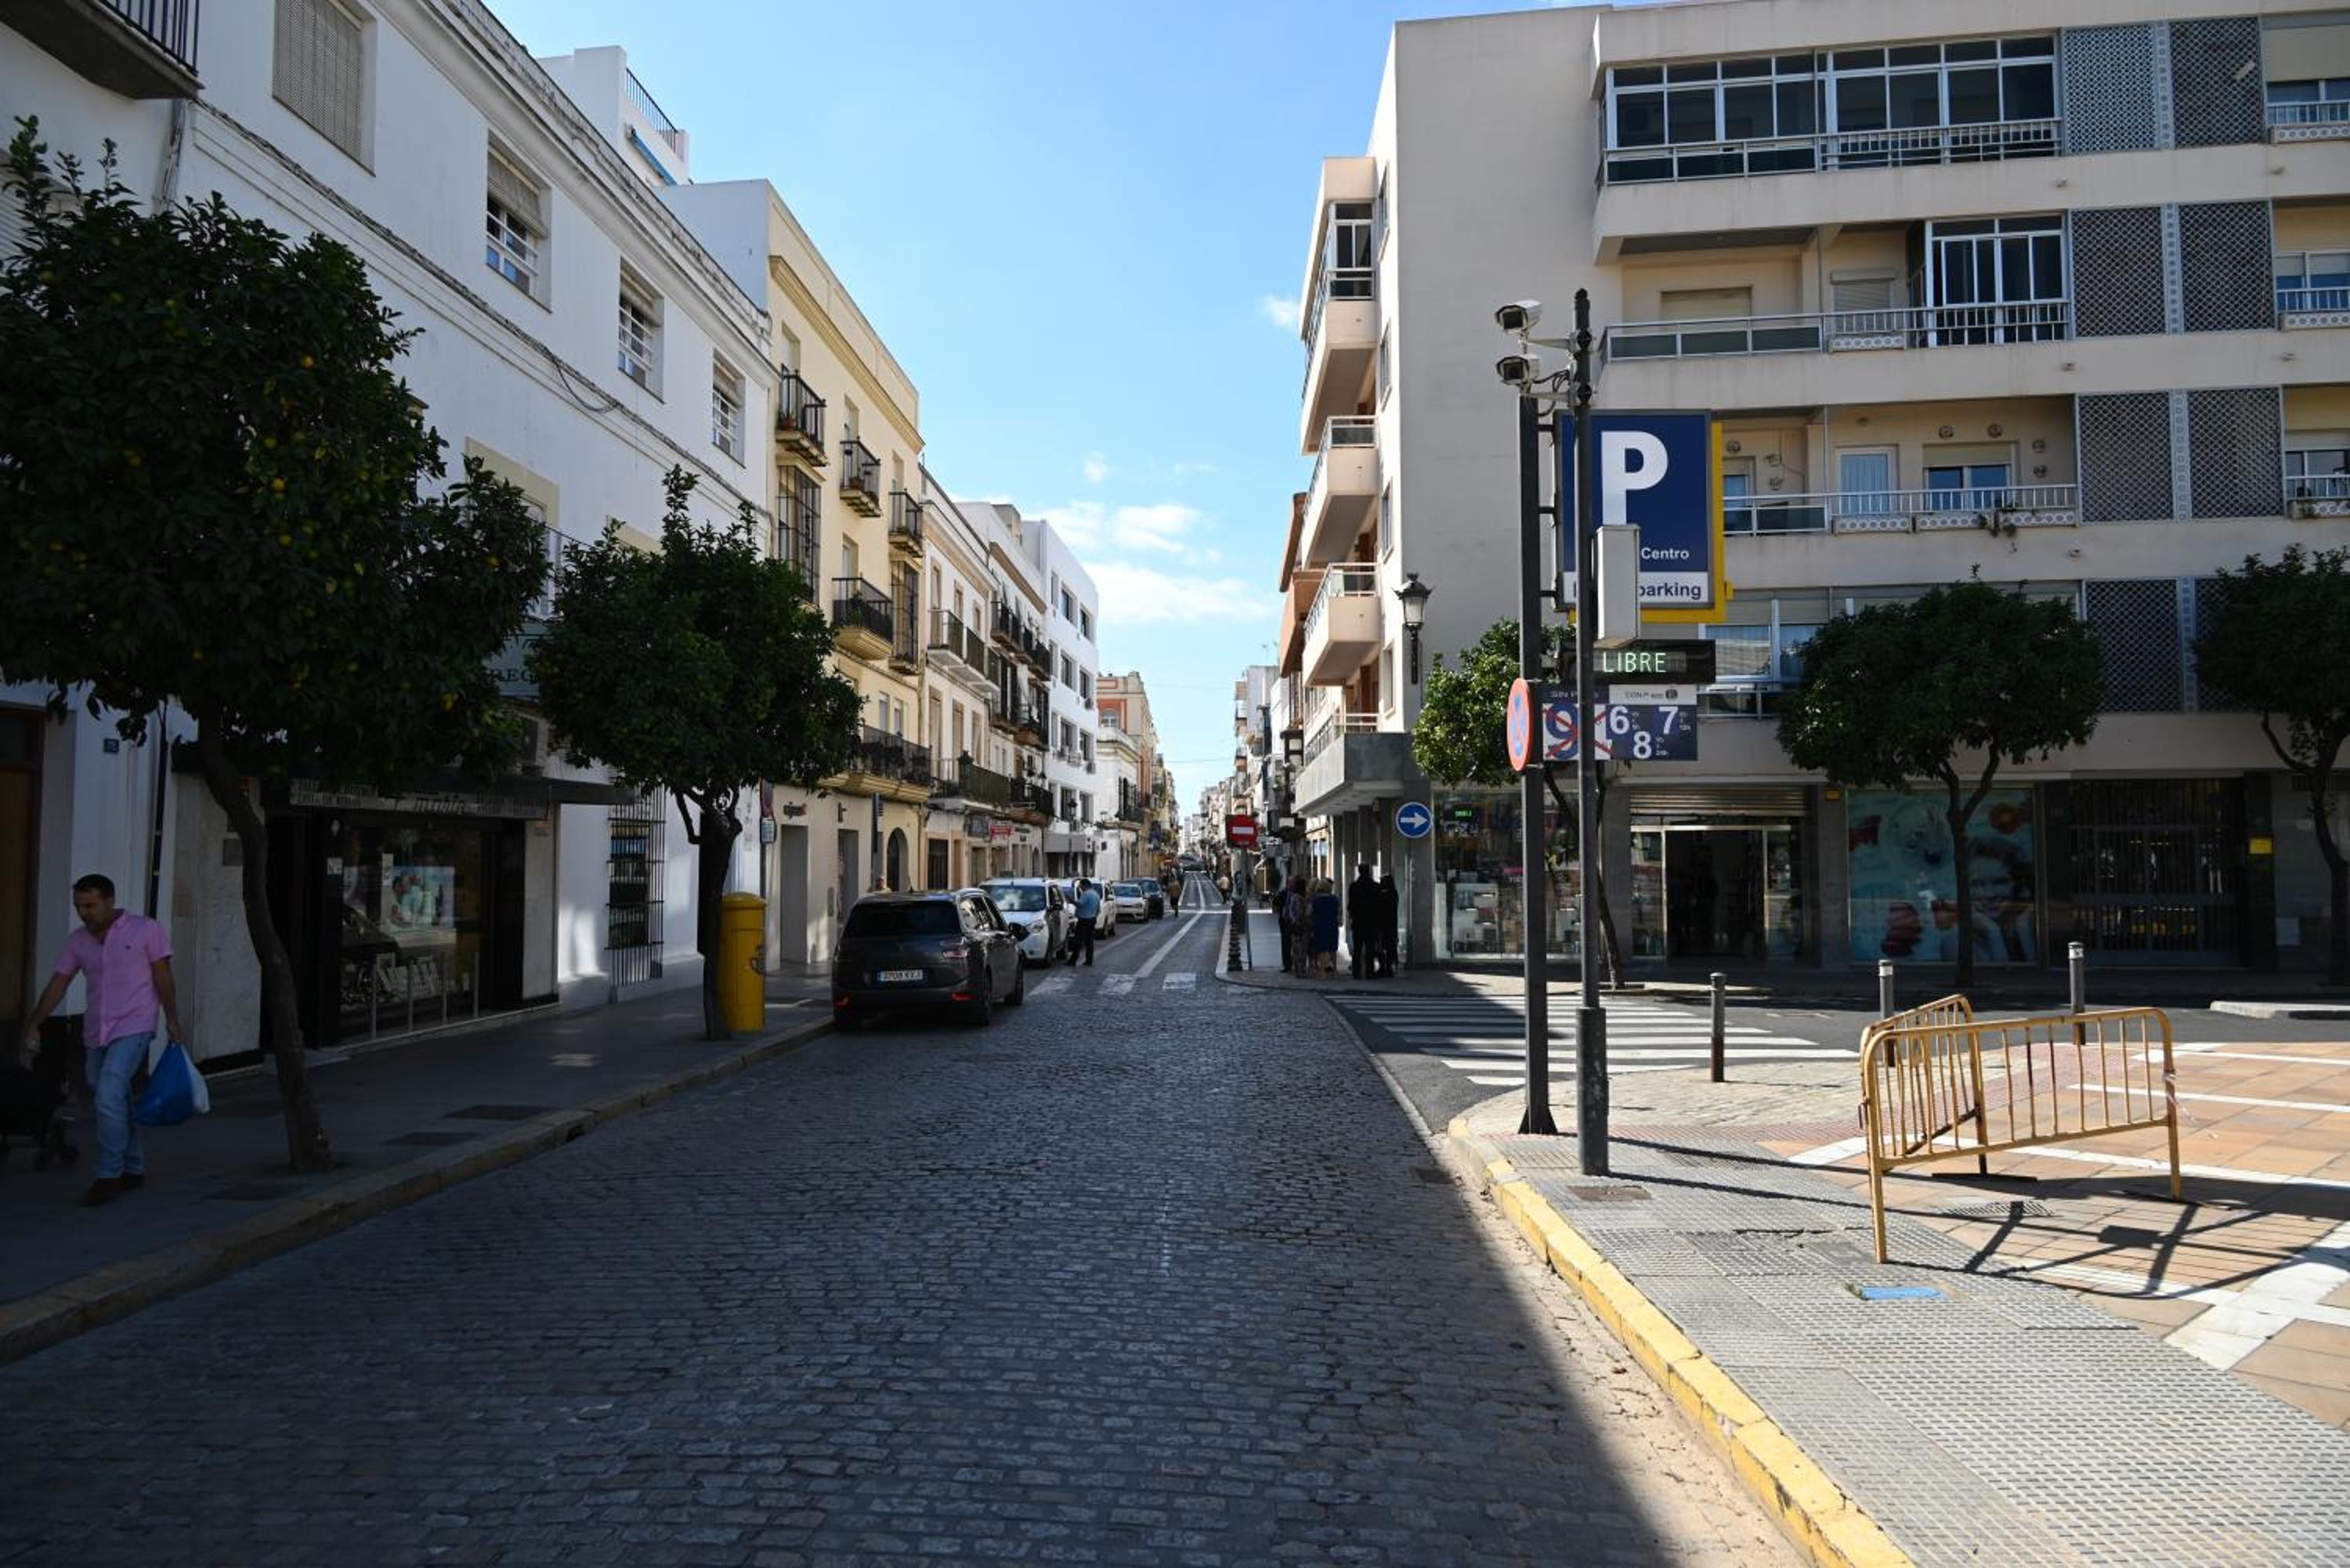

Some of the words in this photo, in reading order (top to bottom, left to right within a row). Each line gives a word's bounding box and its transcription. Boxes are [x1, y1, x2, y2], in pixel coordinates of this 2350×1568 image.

[1601, 430, 1668, 526] P
[1641, 547, 1690, 560] Centro
[1603, 652, 1667, 673] LIBRE
[1610, 706, 1629, 735] 6
[1658, 706, 1679, 735] 7
[1632, 730, 1652, 760] 8
